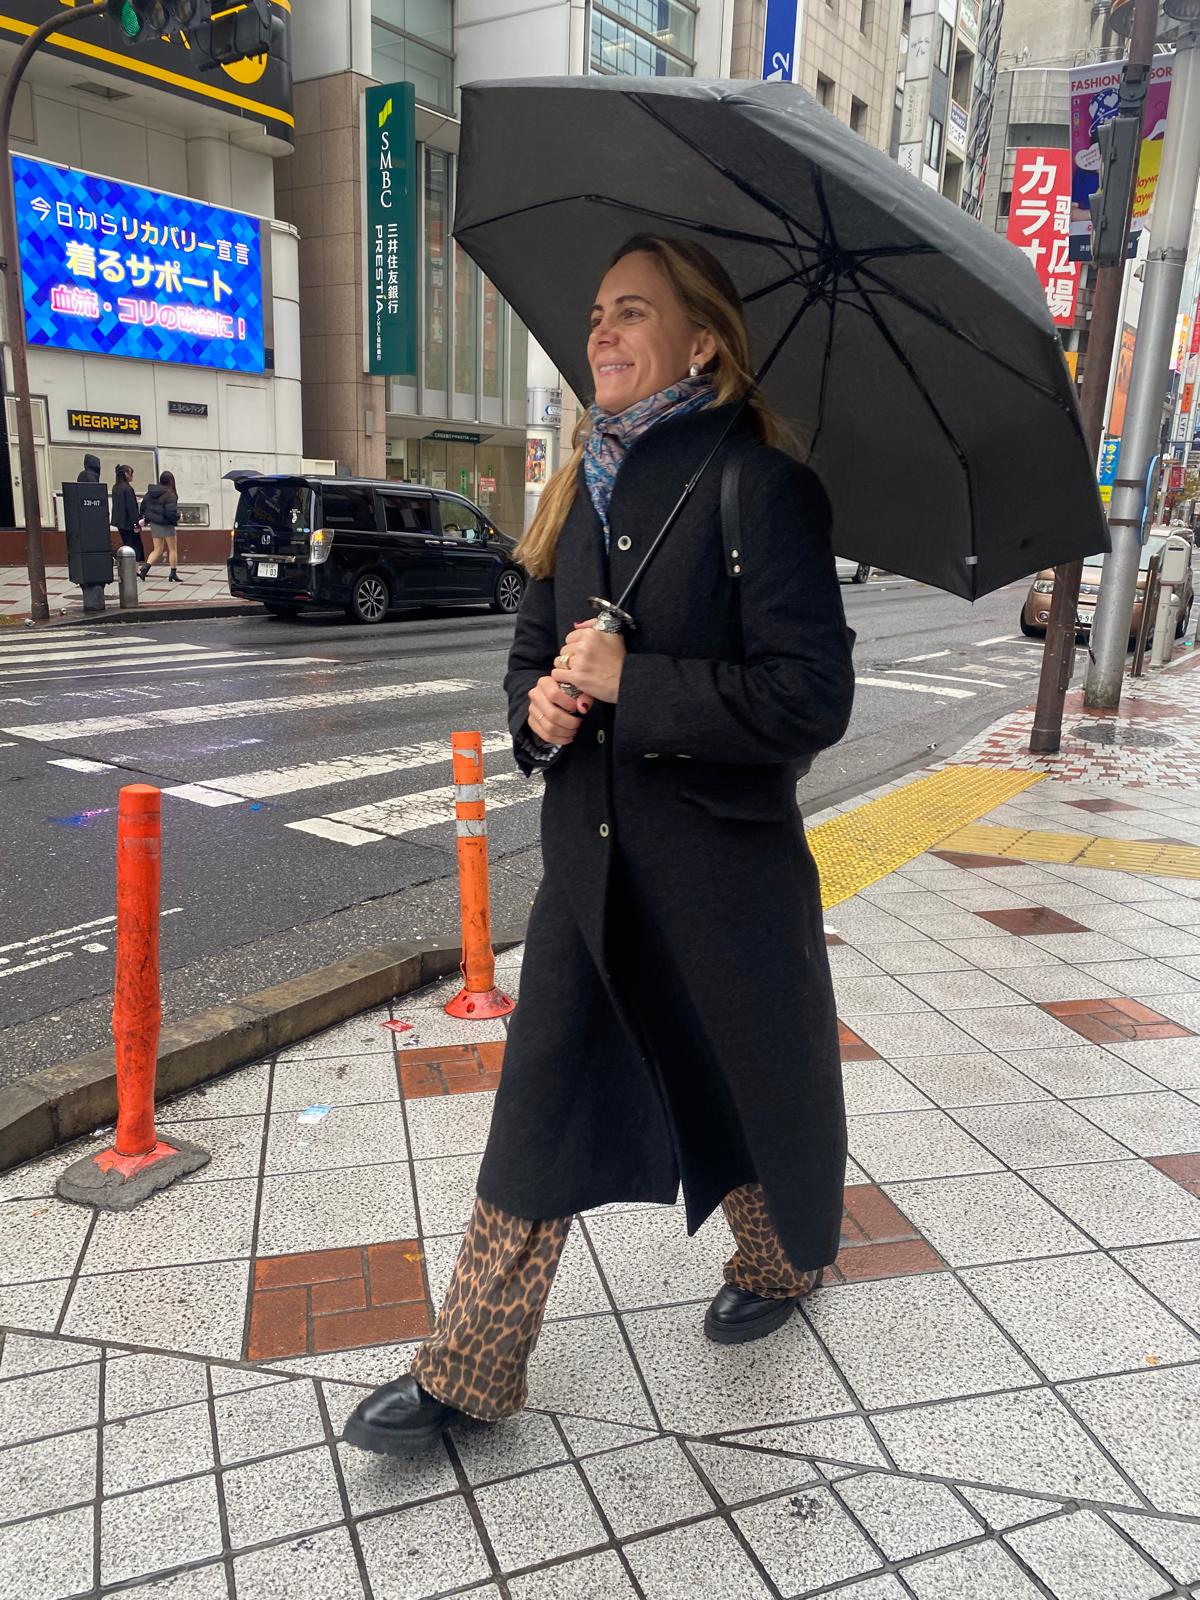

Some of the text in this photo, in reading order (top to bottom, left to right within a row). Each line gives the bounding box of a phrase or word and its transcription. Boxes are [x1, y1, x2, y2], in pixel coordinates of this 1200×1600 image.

[1071, 66, 1173, 92] FASHION SOR
[380, 131, 393, 208] SMBC
[30, 196, 250, 265] 今日からリカバリー宣言
[66, 240, 233, 302] 着るサポート
[387, 223, 399, 314] 三井住友銀行
[72, 414, 139, 431] MEGAドンキ
